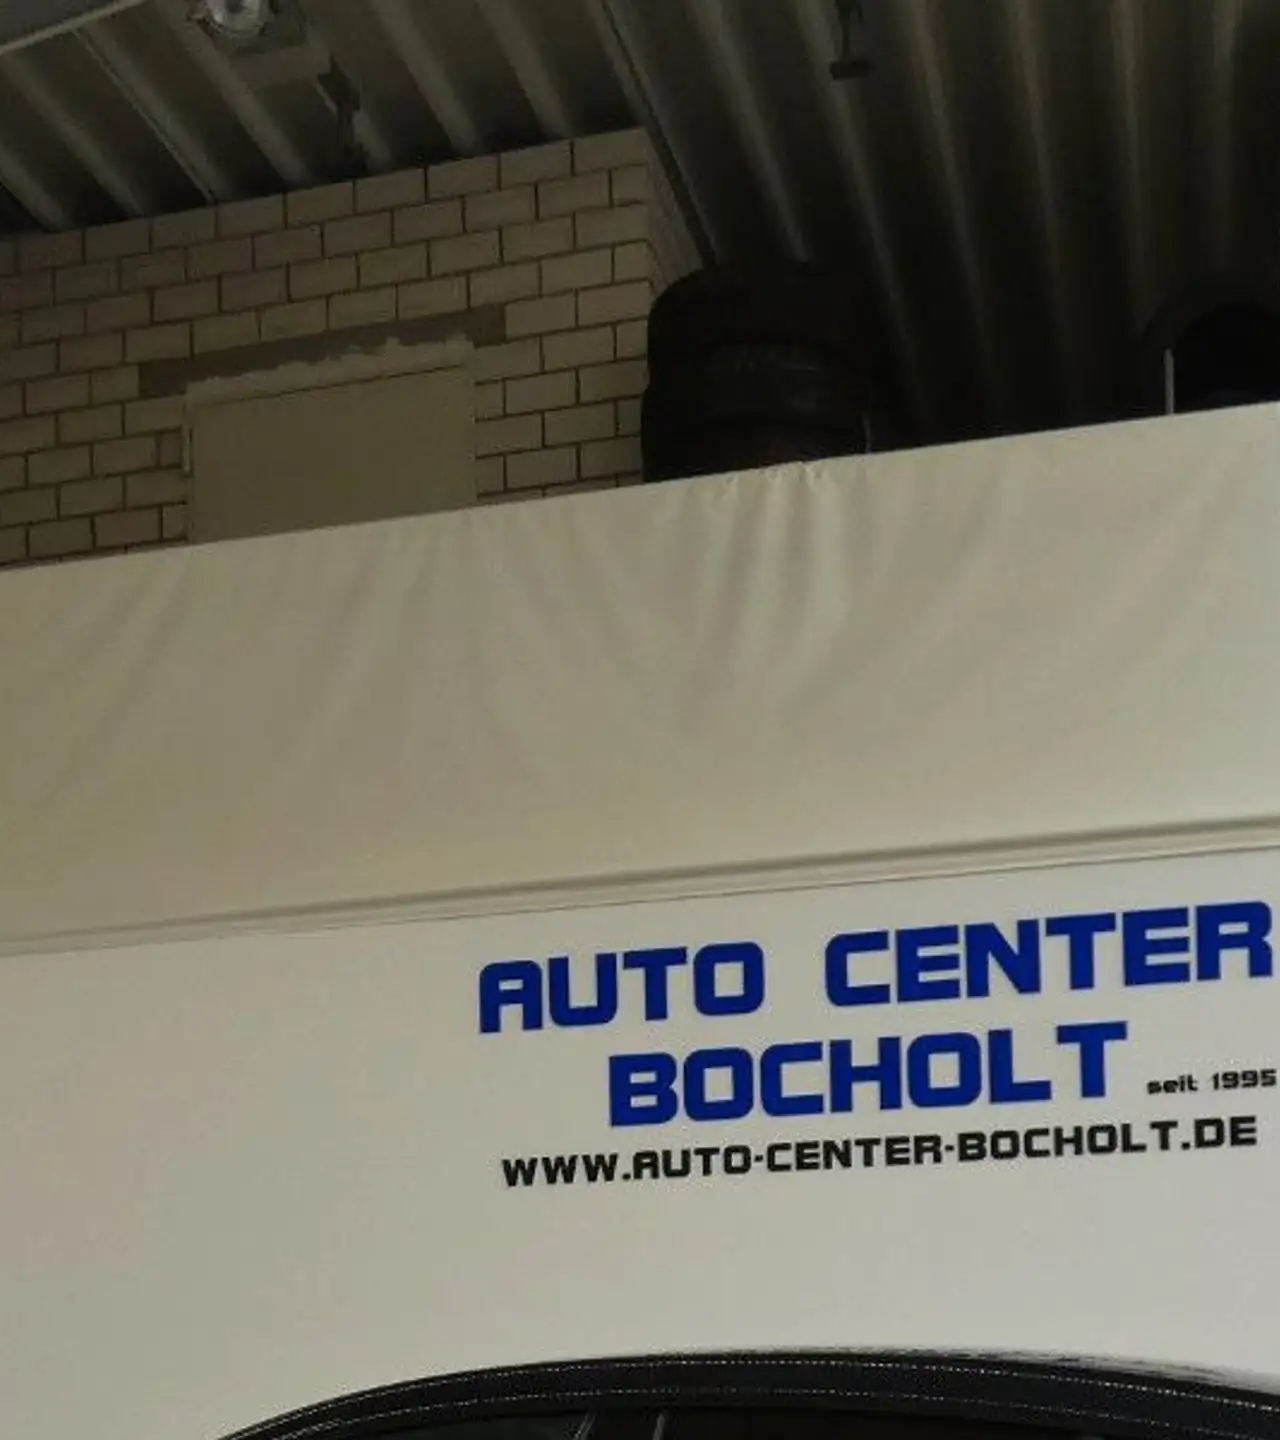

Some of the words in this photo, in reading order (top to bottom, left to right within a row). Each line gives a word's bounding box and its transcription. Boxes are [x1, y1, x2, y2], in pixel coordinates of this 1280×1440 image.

[479, 941, 766, 1033] AUTO
[825, 900, 1275, 1007] CENTER
[609, 1020, 1129, 1128] BOCHOLT
[1146, 1073, 1199, 1095] seit
[1212, 1068, 1278, 1091] 1995
[500, 1114, 1259, 1189] WWW.AUTO-CENTER-BOCHOLT.DE
